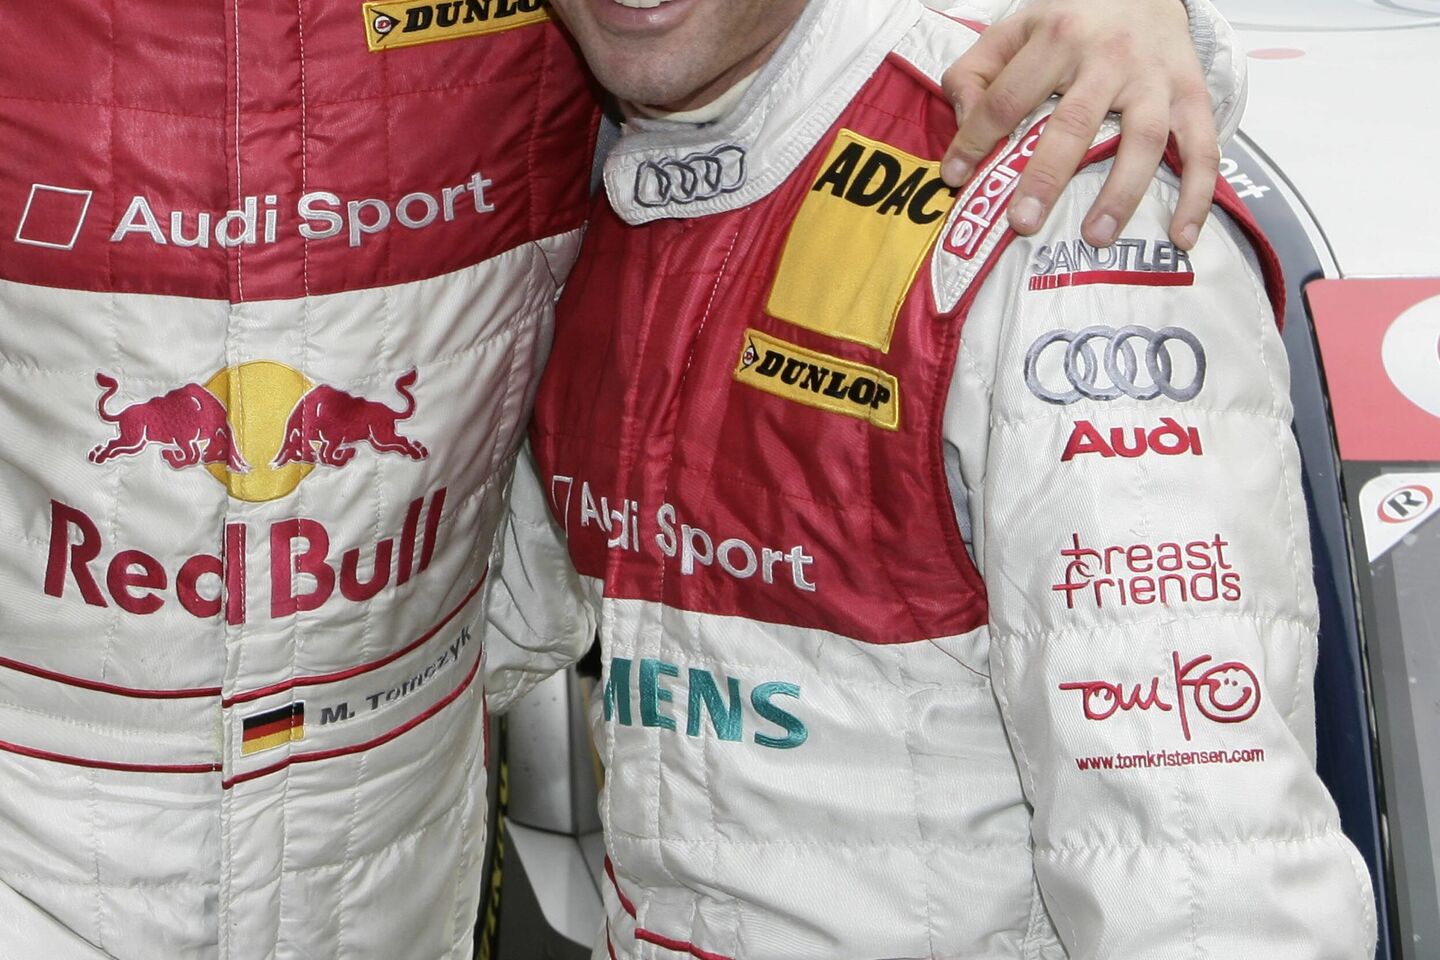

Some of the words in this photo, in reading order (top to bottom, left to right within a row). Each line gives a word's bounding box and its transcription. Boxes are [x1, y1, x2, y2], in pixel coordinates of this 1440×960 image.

[109, 193, 279, 249] Audi
[296, 171, 496, 248] Sport
[811, 141, 958, 225] ADAC
[755, 350, 891, 410] DUNLOP
[1060, 417, 1203, 462] Audi
[44, 498, 247, 626] Red
[270, 486, 448, 619] Bull
[655, 503, 816, 592] Sport
[319, 702, 356, 726] M.
[1075, 748, 1265, 771] www.tomkristensen.com
